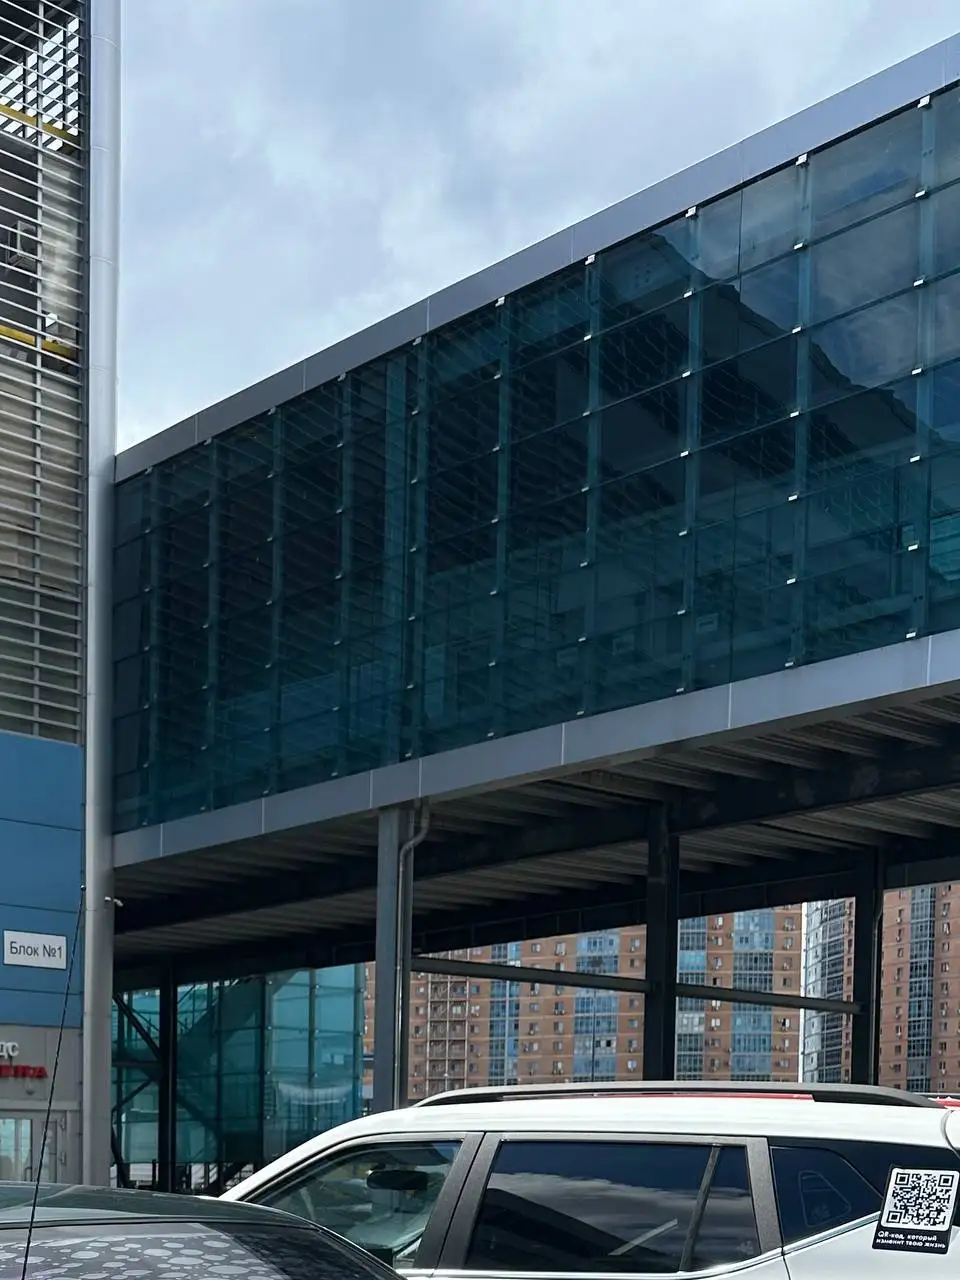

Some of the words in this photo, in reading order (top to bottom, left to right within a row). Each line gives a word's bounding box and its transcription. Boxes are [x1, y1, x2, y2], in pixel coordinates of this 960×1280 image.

[9, 940, 40, 957] Блок
[42, 944, 63, 959] №1
[907, 1234, 937, 1242] который
